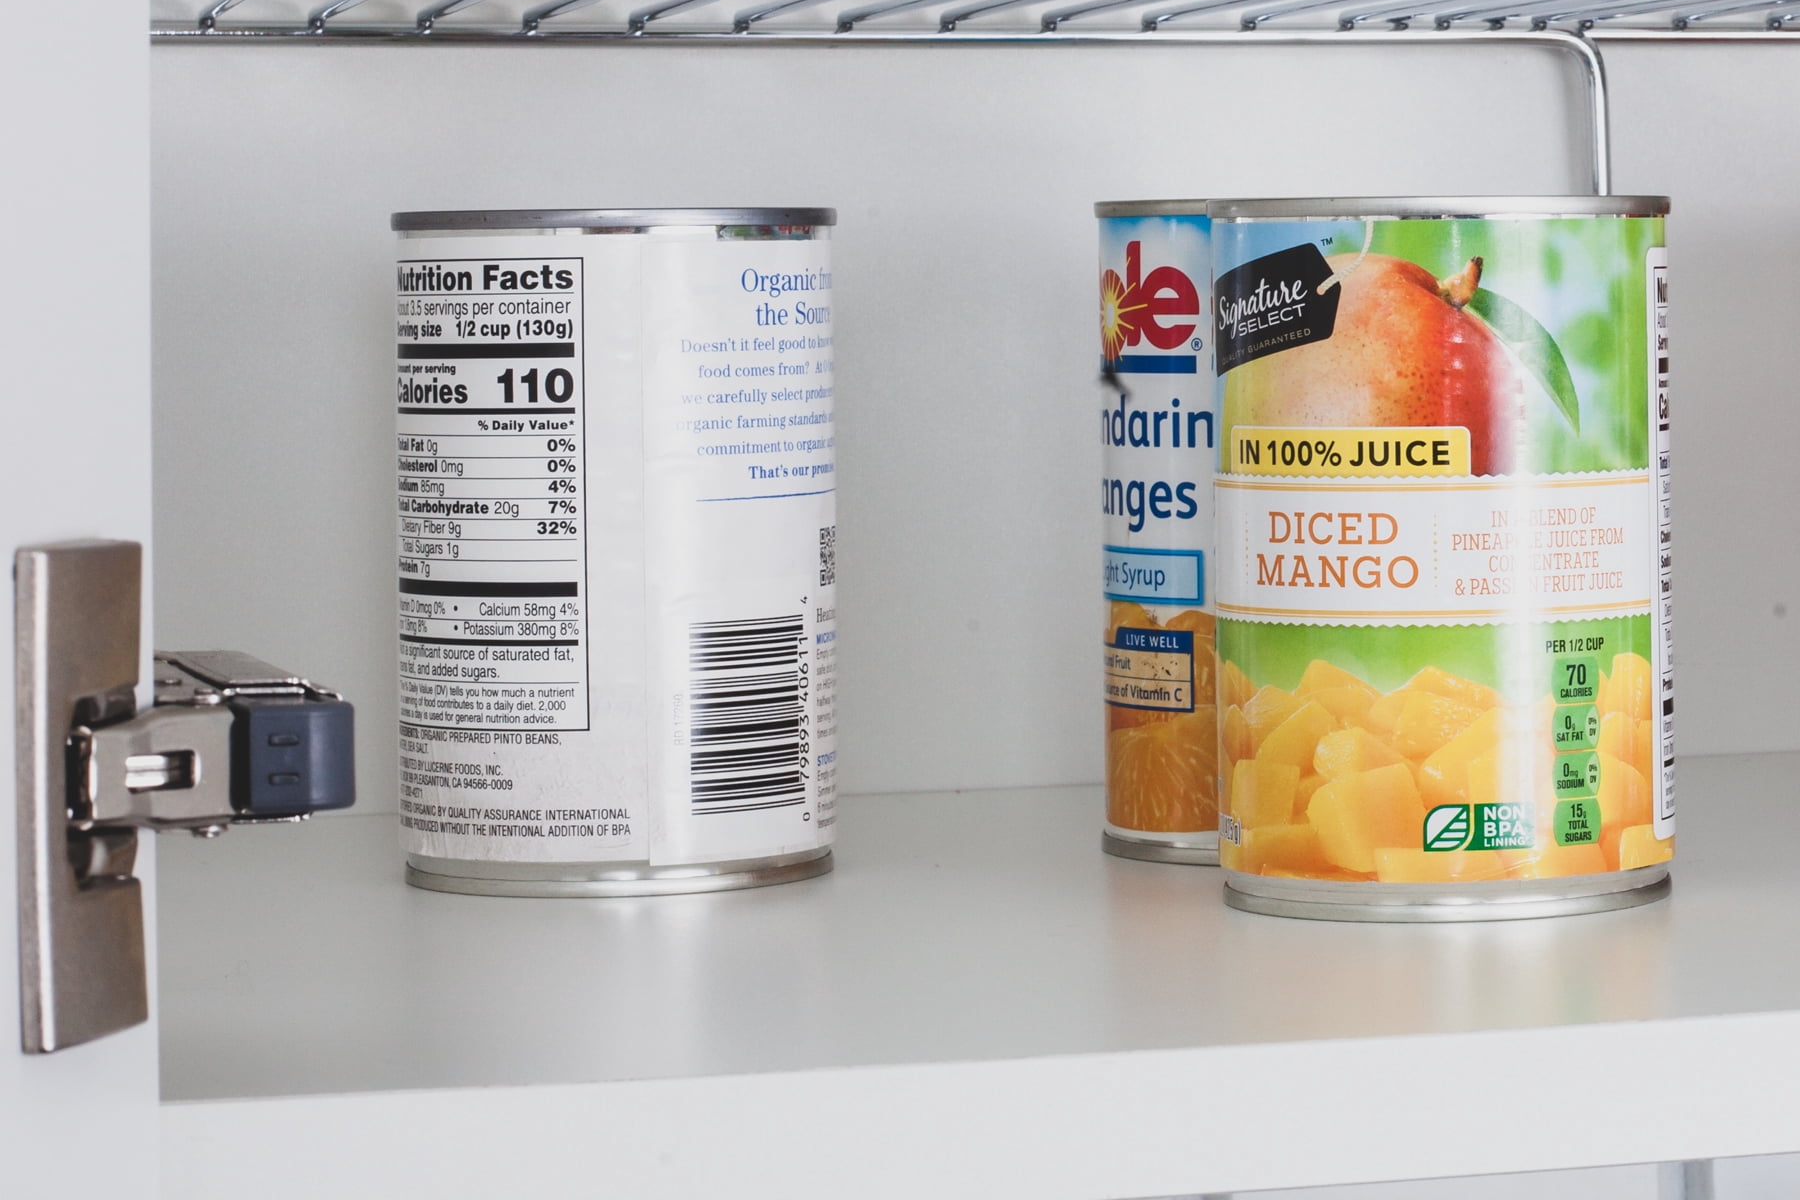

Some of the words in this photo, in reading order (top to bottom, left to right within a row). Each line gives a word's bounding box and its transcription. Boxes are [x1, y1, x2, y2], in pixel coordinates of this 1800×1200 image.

[483, 264, 574, 291] Facts
[741, 268, 817, 298] Organic
[424, 300, 468, 320] servings
[472, 302, 494, 322] per
[498, 298, 571, 315] container
[1219, 276, 1308, 340] Signature
[421, 320, 442, 337] size
[455, 320, 476, 338] 1/2
[480, 323, 511, 340] cup
[516, 319, 573, 340] (130g)
[1238, 303, 1306, 337] SELECT
[1247, 327, 1312, 354] GUARANTEED
[497, 368, 574, 403] 110
[477, 420, 489, 431] %
[492, 420, 524, 433] Daily
[1239, 440, 1260, 466] IN
[1267, 441, 1342, 467] 100%
[1350, 440, 1450, 467] JUICE
[411, 499, 489, 517] Carbohydrate
[494, 501, 519, 517] 20g
[548, 500, 577, 514] 7%
[537, 521, 577, 535] 32%
[1268, 511, 1398, 546] DICED
[1122, 562, 1166, 594] Syrup
[1257, 555, 1419, 589] MANGO
[479, 603, 520, 616] Calcium
[523, 603, 556, 619] 58mg
[559, 603, 579, 616] 4%
[463, 622, 514, 636] Potassium
[517, 623, 556, 638] 380mg
[559, 623, 580, 636] 8%
[1126, 633, 1146, 648] LIVE
[1149, 635, 1179, 649] WELL
[1545, 639, 1566, 653] PER
[1569, 638, 1583, 652] 1/2
[1586, 636, 1604, 651] CUP
[1566, 663, 1586, 685] 70
[1130, 684, 1170, 702] Vitamin
[546, 809, 630, 821] INTERNATIONAL
[1484, 806, 1526, 821] NON
[1484, 823, 1525, 837] BPA
